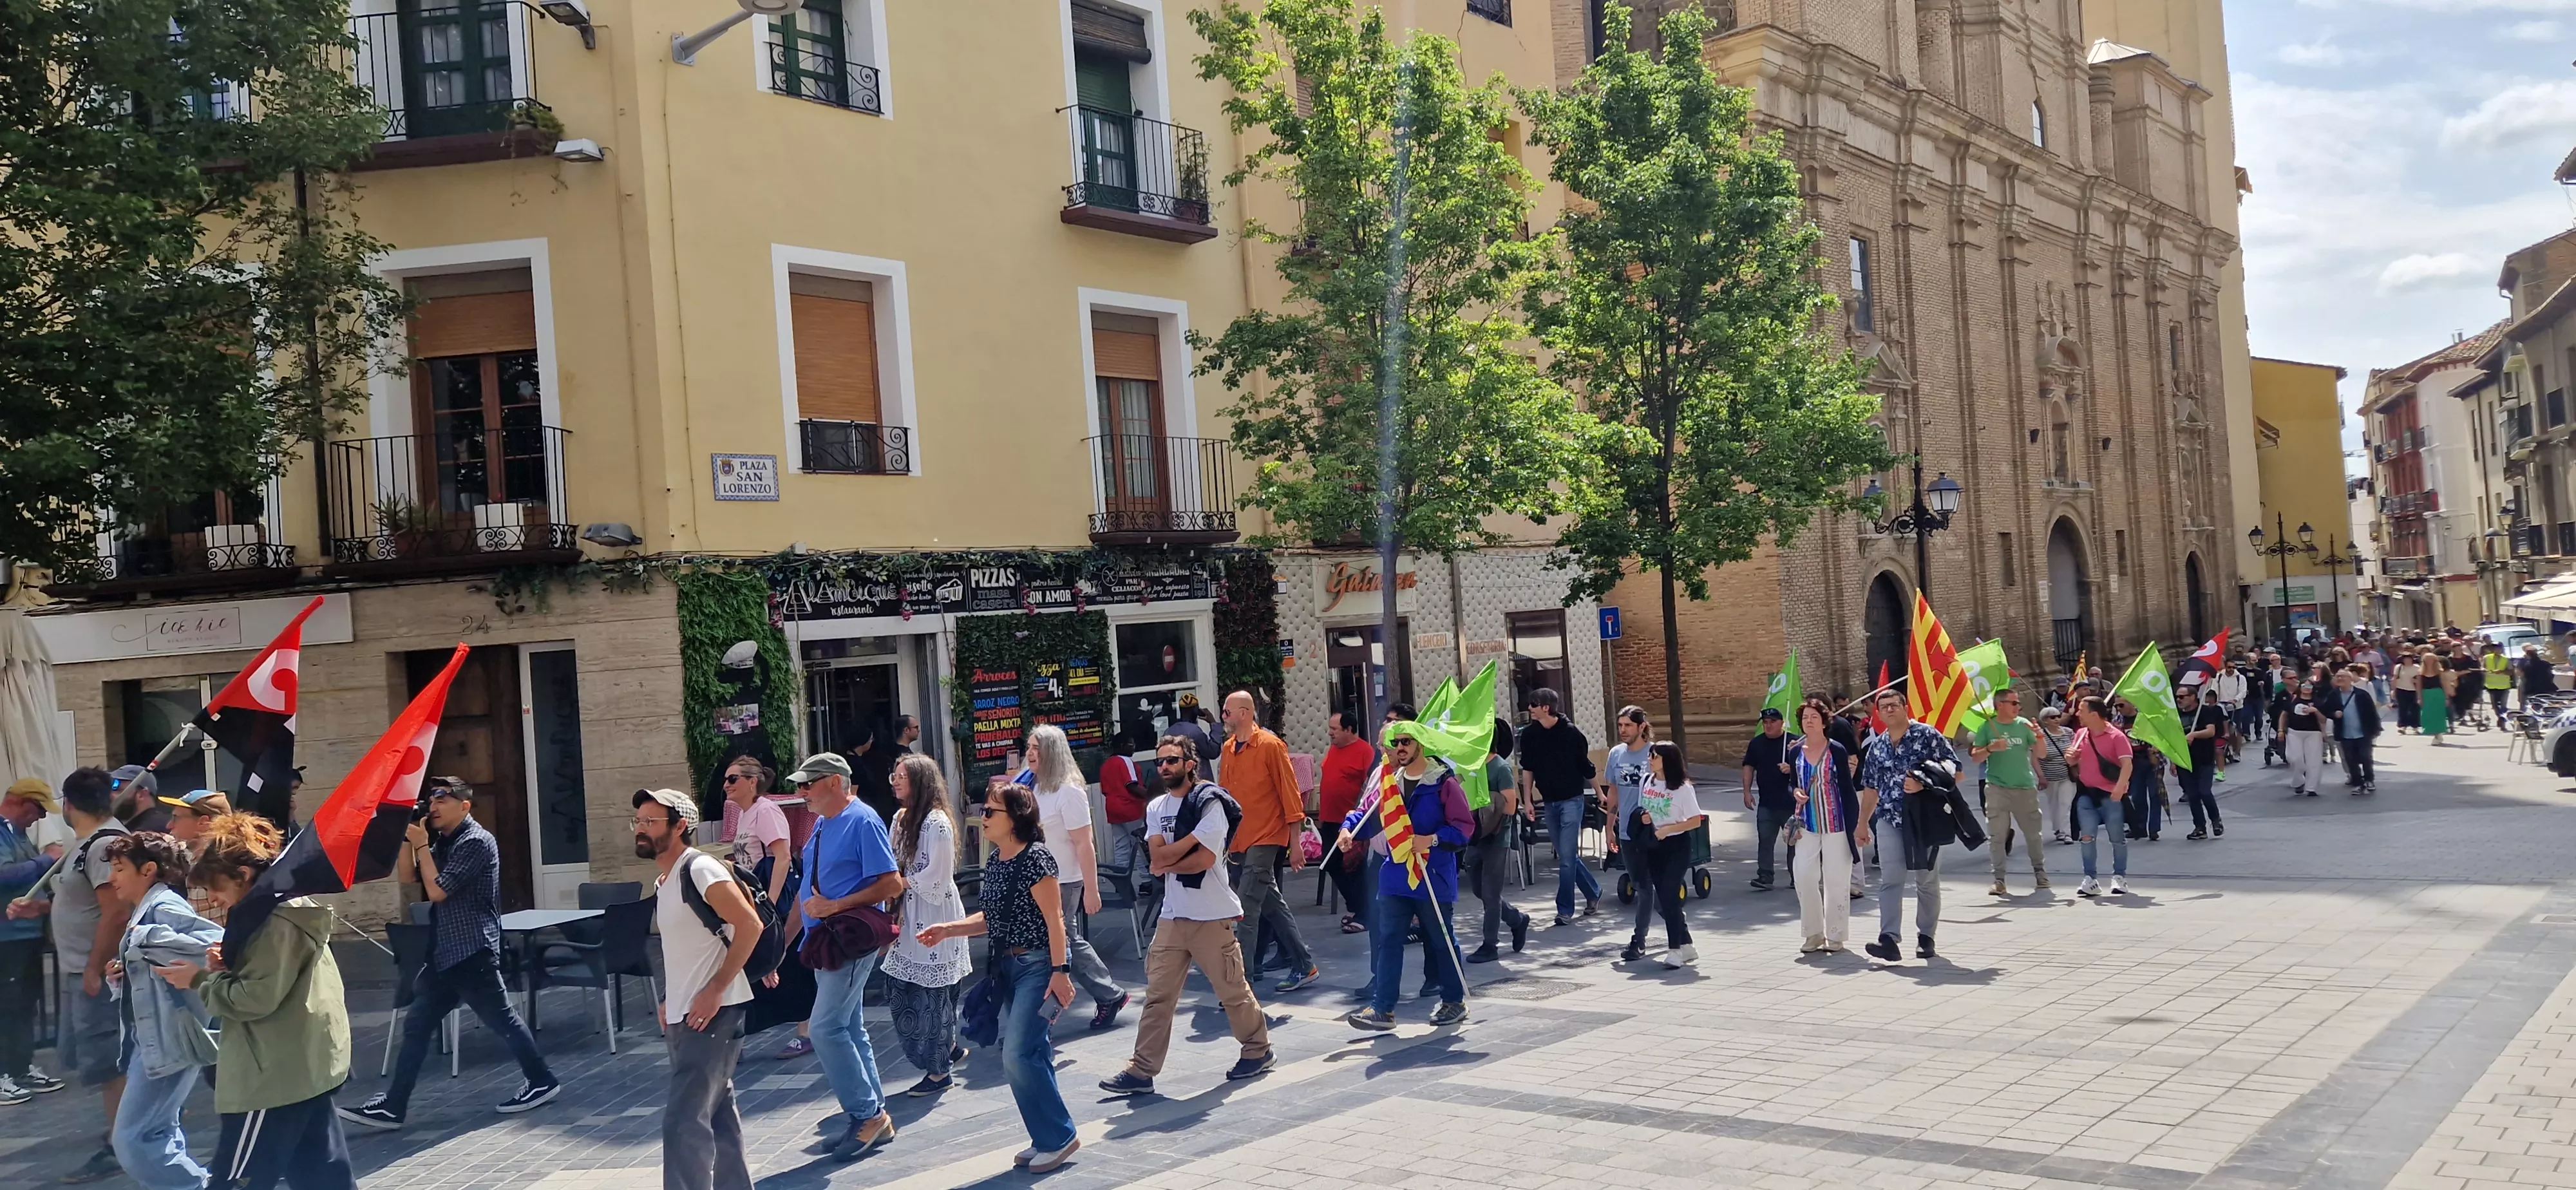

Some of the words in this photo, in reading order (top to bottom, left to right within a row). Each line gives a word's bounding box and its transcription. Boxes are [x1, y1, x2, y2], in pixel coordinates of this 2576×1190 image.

[739, 461, 768, 470] PLAZA
[737, 472, 762, 482] SAN
[723, 484, 772, 494] LORENZO
[971, 567, 1016, 588] PIZZAS
[1151, 585, 1164, 593] por
[1165, 584, 1190, 592] supuesto
[1321, 562, 1417, 612] Galaea
[977, 589, 1010, 599] masa
[1045, 589, 1072, 603] AMOR
[1171, 590, 1189, 600] pasta
[831, 604, 874, 616] restaurante
[972, 599, 1018, 610] casera
[460, 614, 491, 636] 24
[1309, 642, 1318, 658] 2
[971, 668, 1018, 684] Arroces
[1037, 663, 1061, 677] izza
[973, 697, 996, 708] ARROZ
[998, 695, 1019, 706] NEGRO
[988, 706, 1021, 719] SEÑORITO
[974, 720, 999, 732] PAELLA
[1000, 717, 1021, 729] MIXTA
[974, 728, 1023, 742] PRUÉBALOS
[976, 749, 990, 759] LOS
